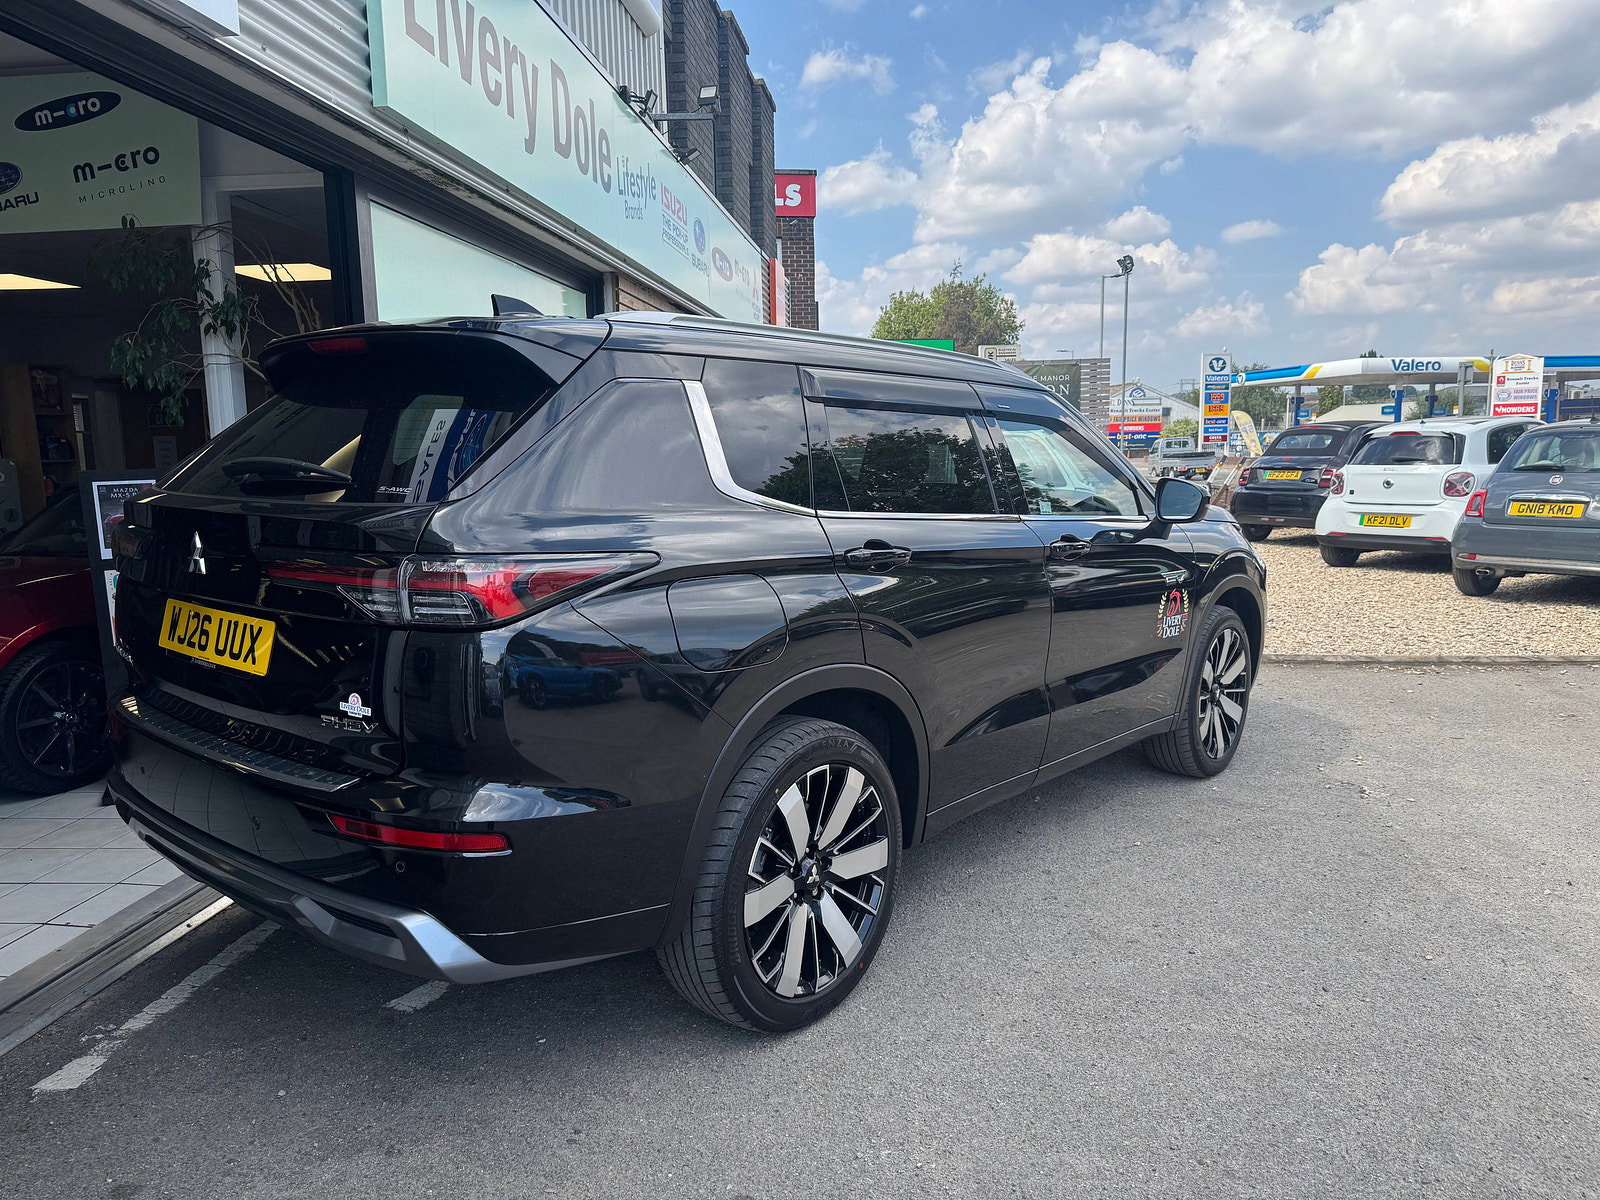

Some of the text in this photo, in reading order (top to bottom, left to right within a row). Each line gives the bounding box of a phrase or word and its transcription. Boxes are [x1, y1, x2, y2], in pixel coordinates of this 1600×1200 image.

[550, 58, 611, 193] Dole
[79, 176, 166, 203] MICROLINO
[617, 156, 656, 209] Lifestyle
[0, 191, 40, 212] ARU
[625, 200, 644, 220] Brands
[661, 182, 688, 226] ISUZU
[1392, 359, 1442, 372] Valero
[1502, 405, 1536, 413] HOWDENS
[378, 485, 412, 493] S-AWC
[1517, 503, 1574, 515] GN18 KMO
[1366, 516, 1408, 525] KF21 DLV
[1163, 615, 1182, 628] LIVERY
[167, 605, 264, 666] WJ26 UUX
[1163, 626, 1180, 639] DOLE
[320, 715, 379, 734] PHEV
